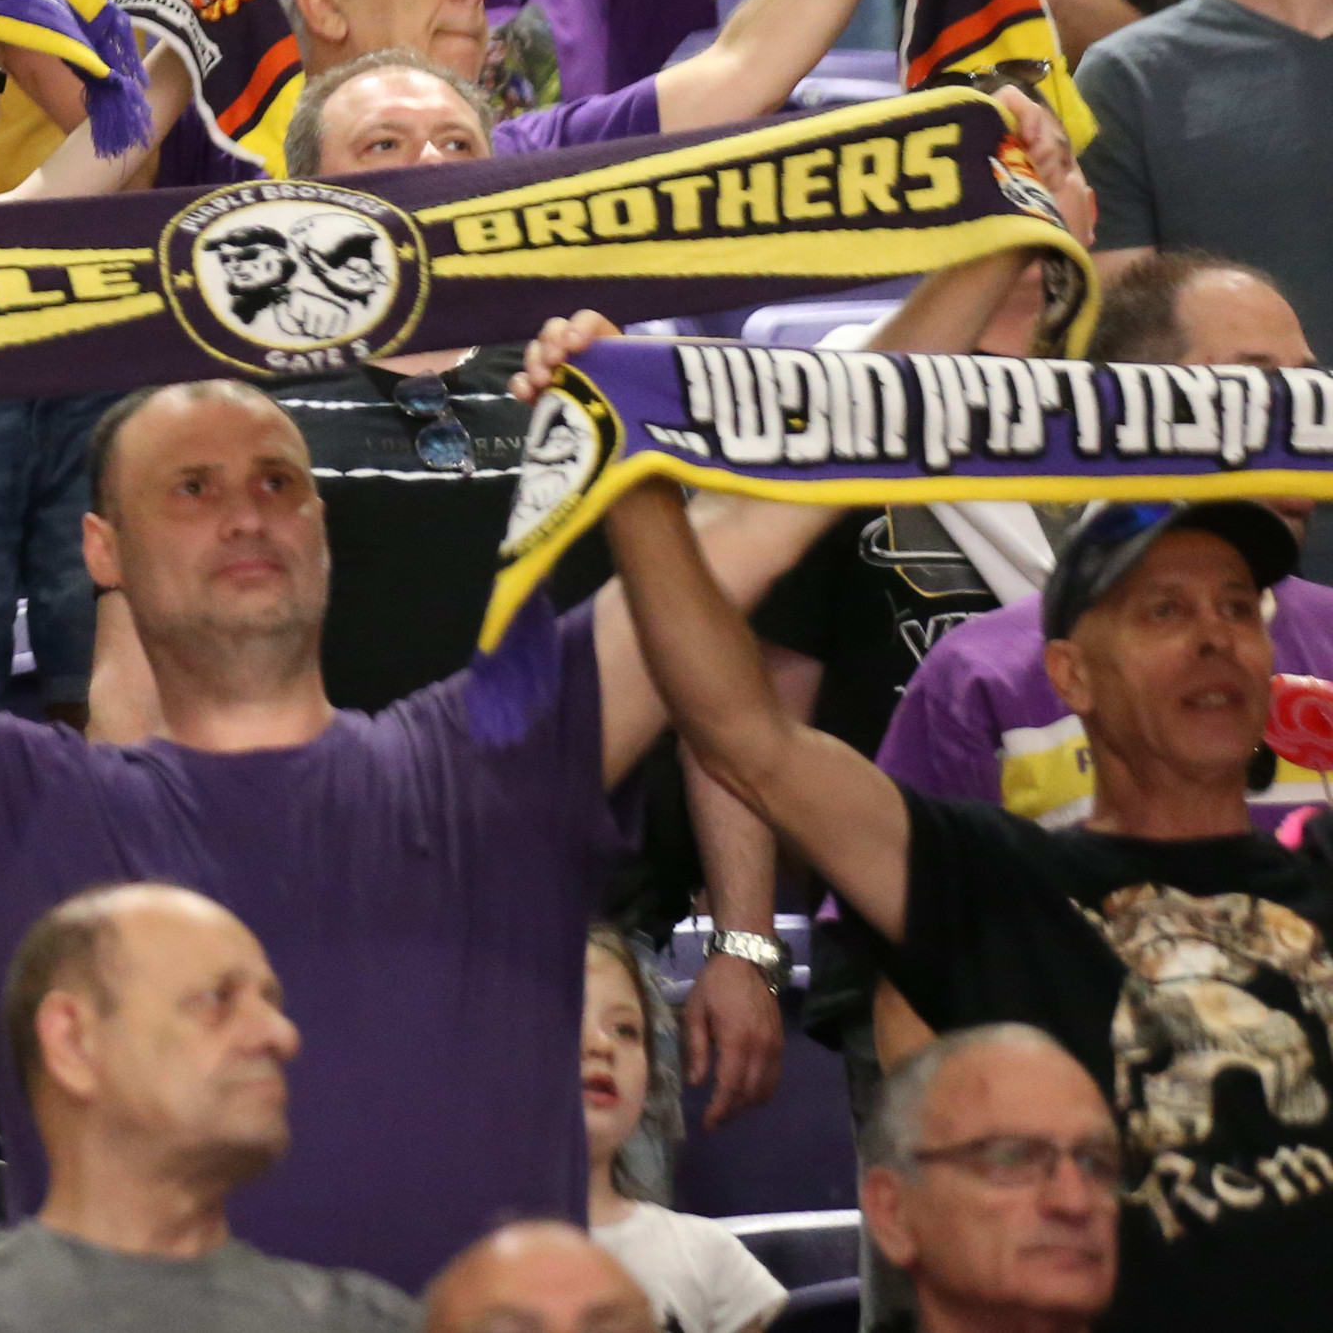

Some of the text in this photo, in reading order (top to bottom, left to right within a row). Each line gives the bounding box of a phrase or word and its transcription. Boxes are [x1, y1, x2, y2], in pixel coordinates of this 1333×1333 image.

[179, 183, 389, 234] PURPLE BROTHERS
[454, 122, 966, 254] BROTHERS
[910, 352, 1101, 470] דימיון
[1115, 362, 1271, 465] קצת
